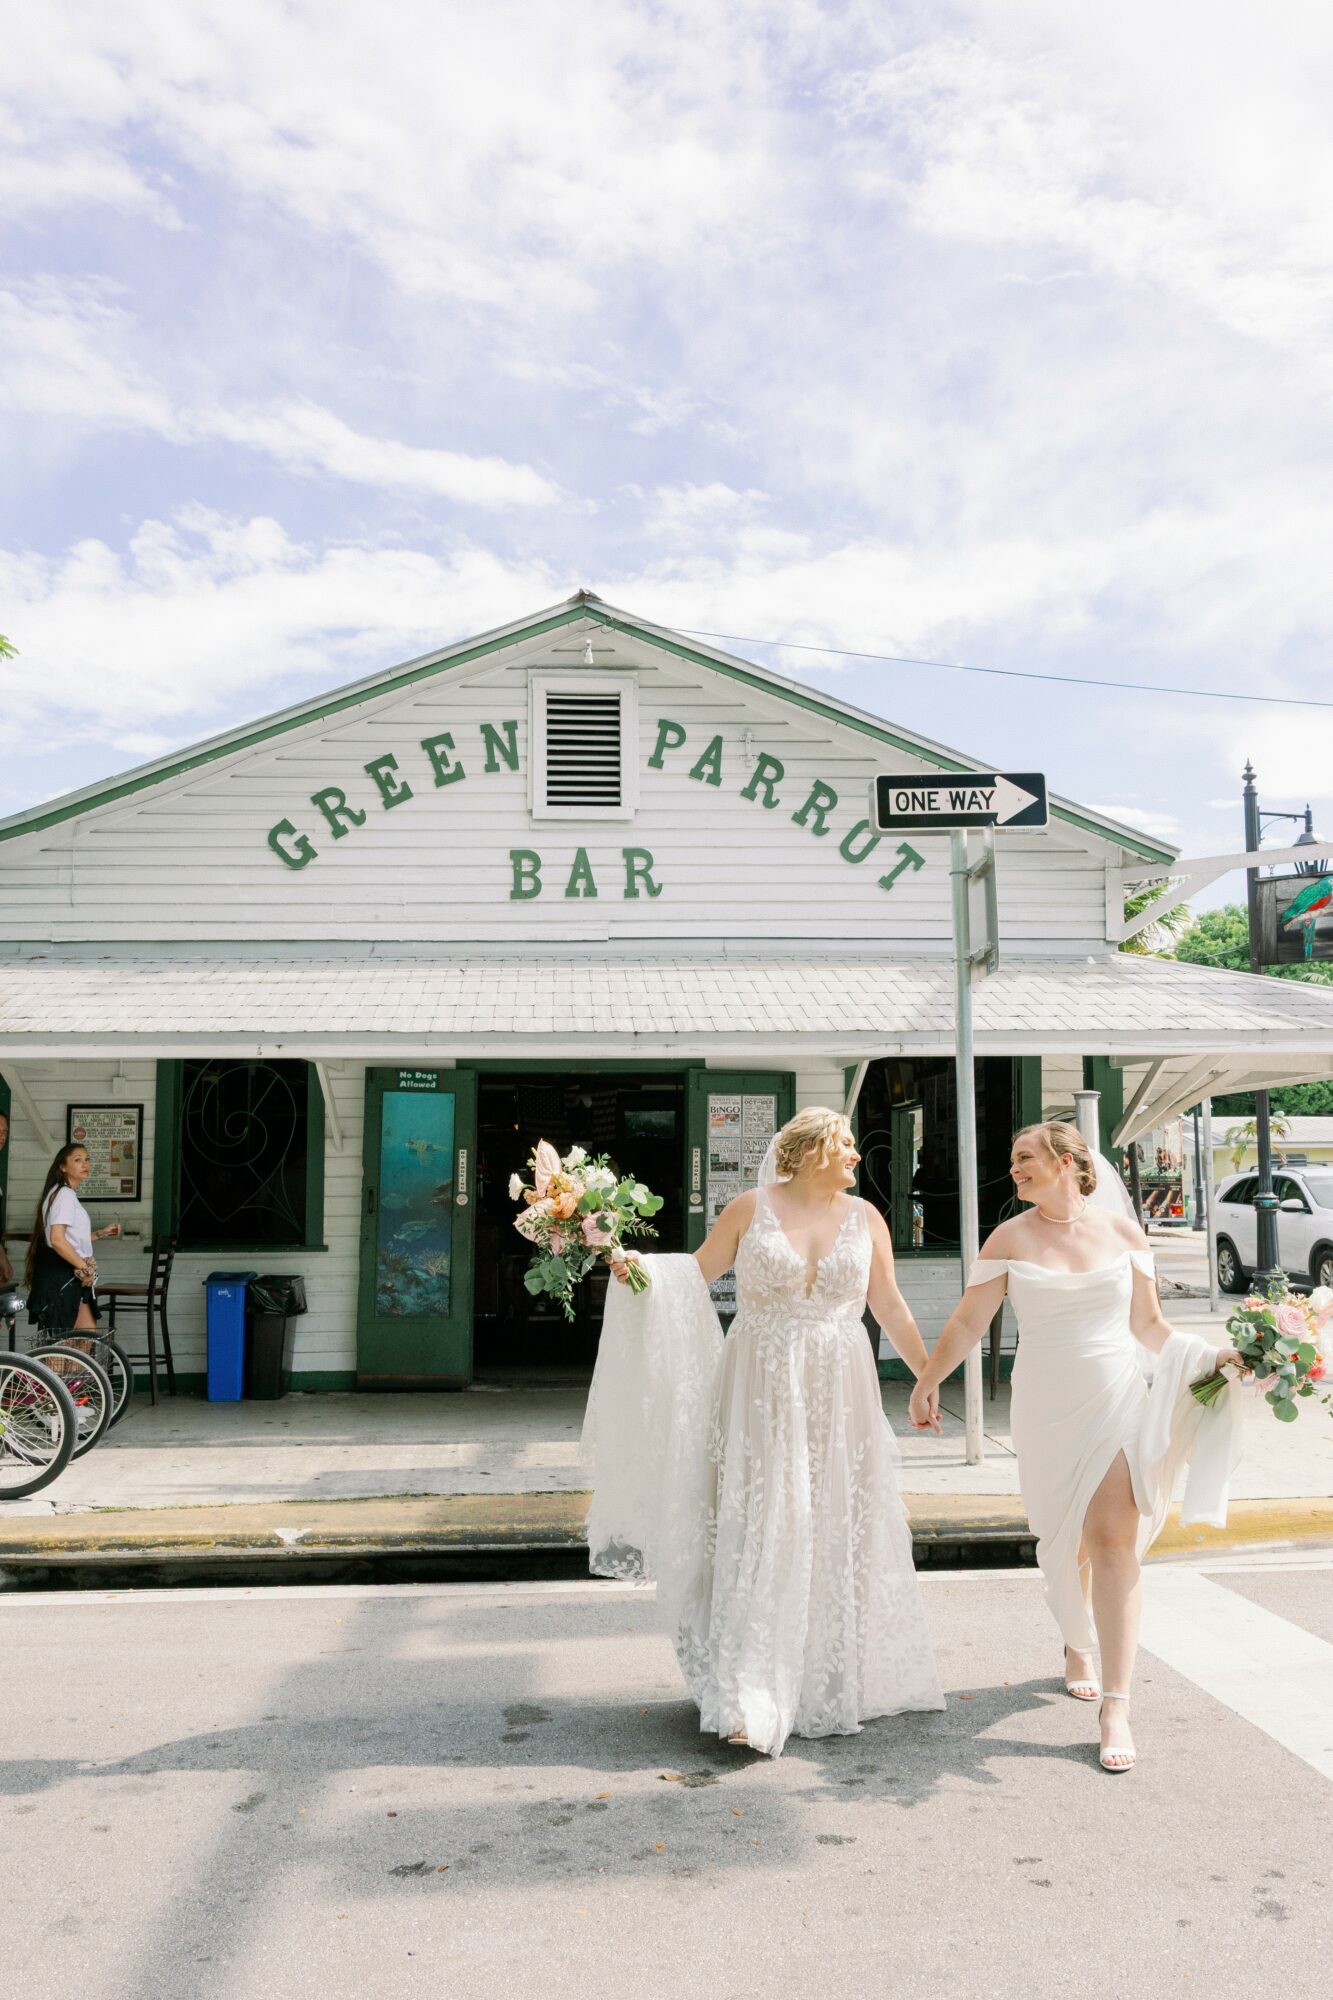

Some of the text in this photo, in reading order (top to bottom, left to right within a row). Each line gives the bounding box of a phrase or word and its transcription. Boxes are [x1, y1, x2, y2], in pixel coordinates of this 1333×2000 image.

[268, 719, 926, 891] GREEN PARROT
[895, 790, 996, 812] ONE WAY
[509, 847, 663, 900] BAR
[399, 1071, 438, 1080] No Dogs
[399, 1080, 437, 1089] Allowed
[694, 1150, 699, 1158] NO
